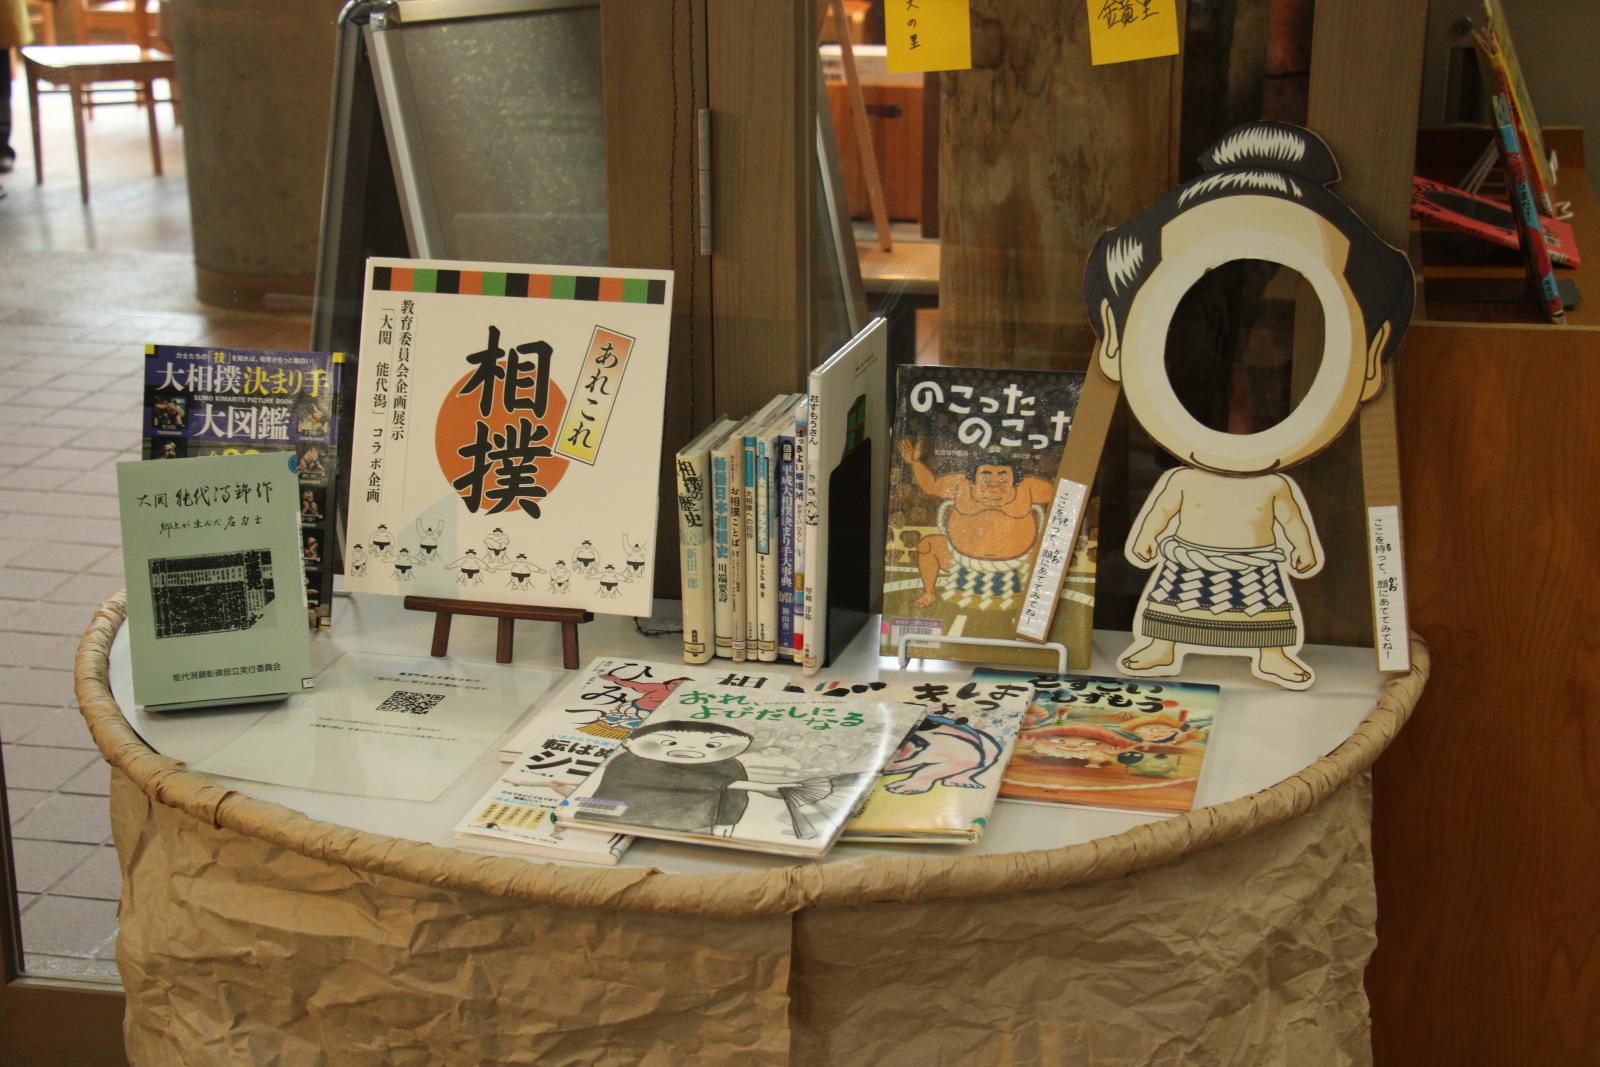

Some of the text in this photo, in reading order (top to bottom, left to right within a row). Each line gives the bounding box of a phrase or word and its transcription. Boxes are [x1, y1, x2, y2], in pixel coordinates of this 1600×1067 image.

[156, 362, 329, 398] 大相撲決まり手
[391, 299, 415, 441] 教育委員会企画展示
[567, 343, 619, 450] あれこれ
[910, 381, 1036, 416] のこった
[194, 404, 290, 440] 大図鑑
[453, 326, 554, 519] 相撲
[809, 394, 819, 446] おすもうさん
[366, 427, 384, 503] コラボ企画
[136, 493, 168, 509] 大関
[565, 663, 653, 725] ひみつ
